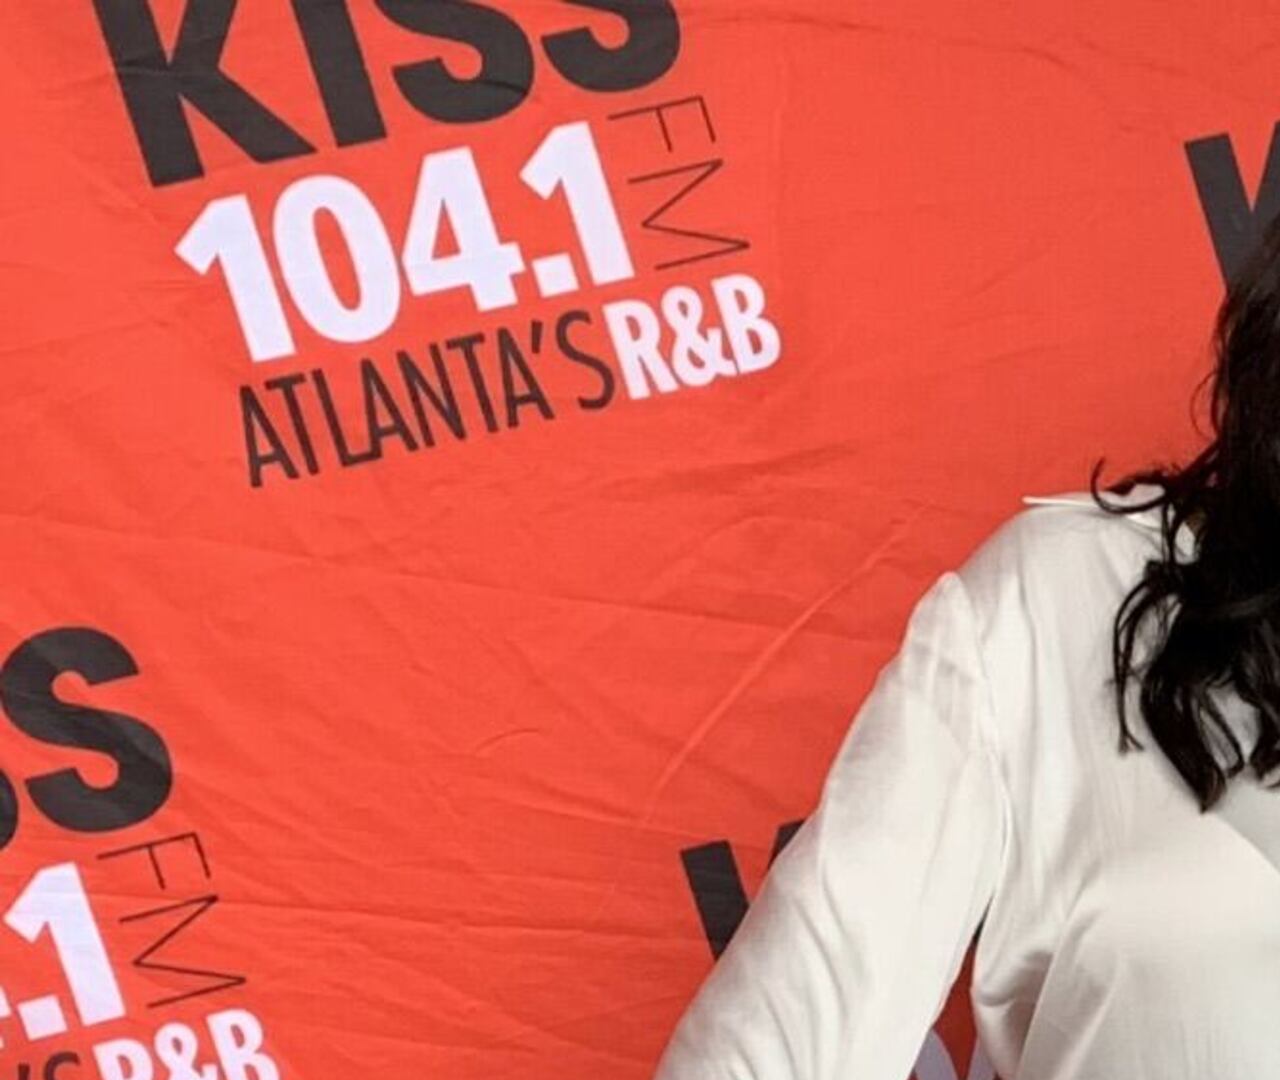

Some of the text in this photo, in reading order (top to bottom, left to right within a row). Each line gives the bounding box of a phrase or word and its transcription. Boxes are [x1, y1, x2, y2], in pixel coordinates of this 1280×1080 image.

[174, 121, 635, 362] 104.1
[606, 95, 750, 271] FM
[238, 274, 782, 488] ATLANTA'S R&B
[97, 832, 246, 1009] FM
